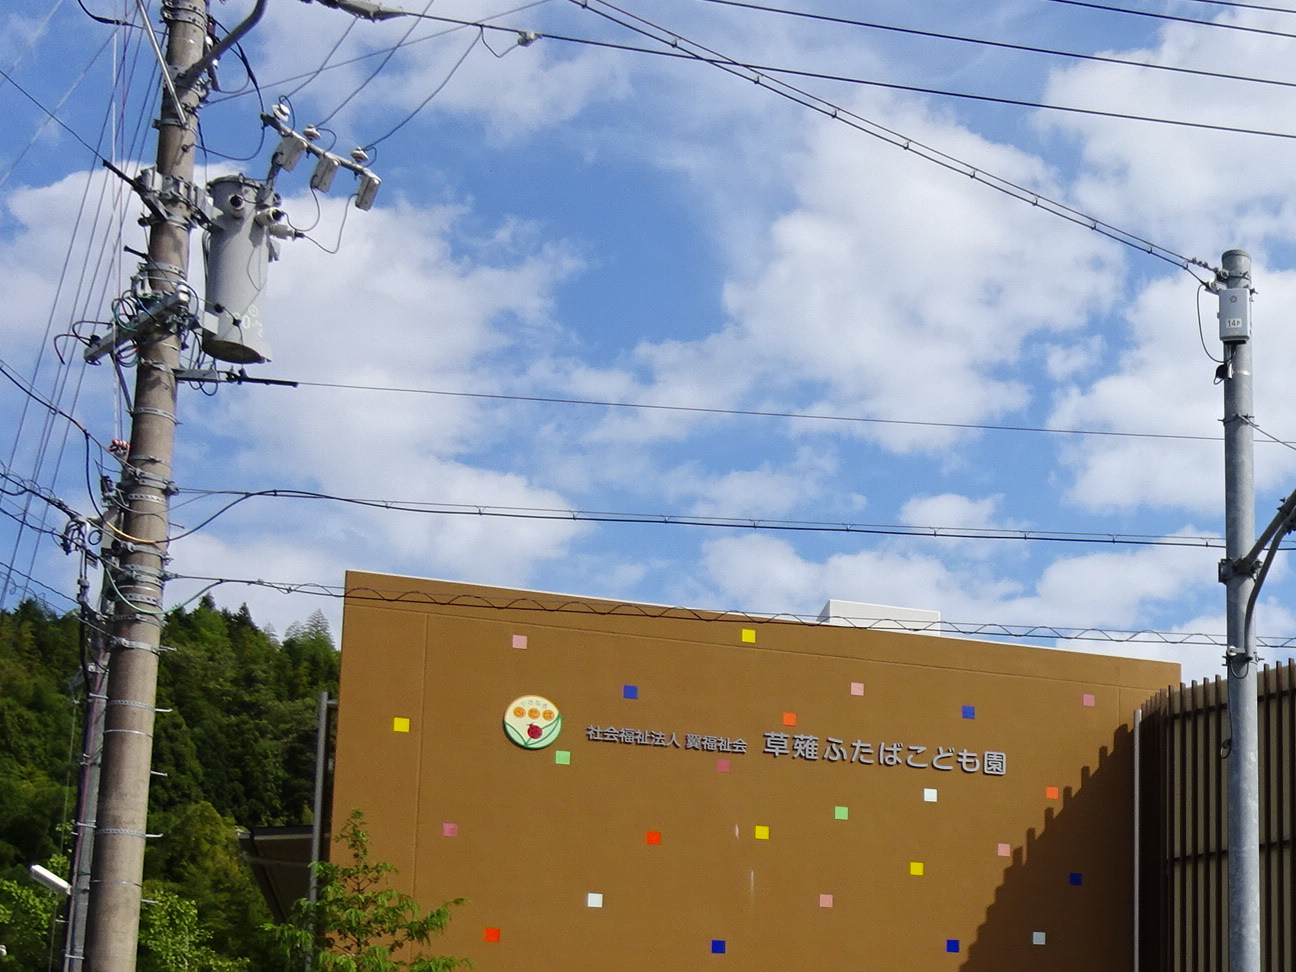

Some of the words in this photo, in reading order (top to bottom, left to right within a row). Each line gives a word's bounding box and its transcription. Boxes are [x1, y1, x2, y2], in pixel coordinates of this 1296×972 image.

[586, 725, 681, 748] 社会福祉法人
[763, 731, 1007, 775] 草薙ふたばこども園
